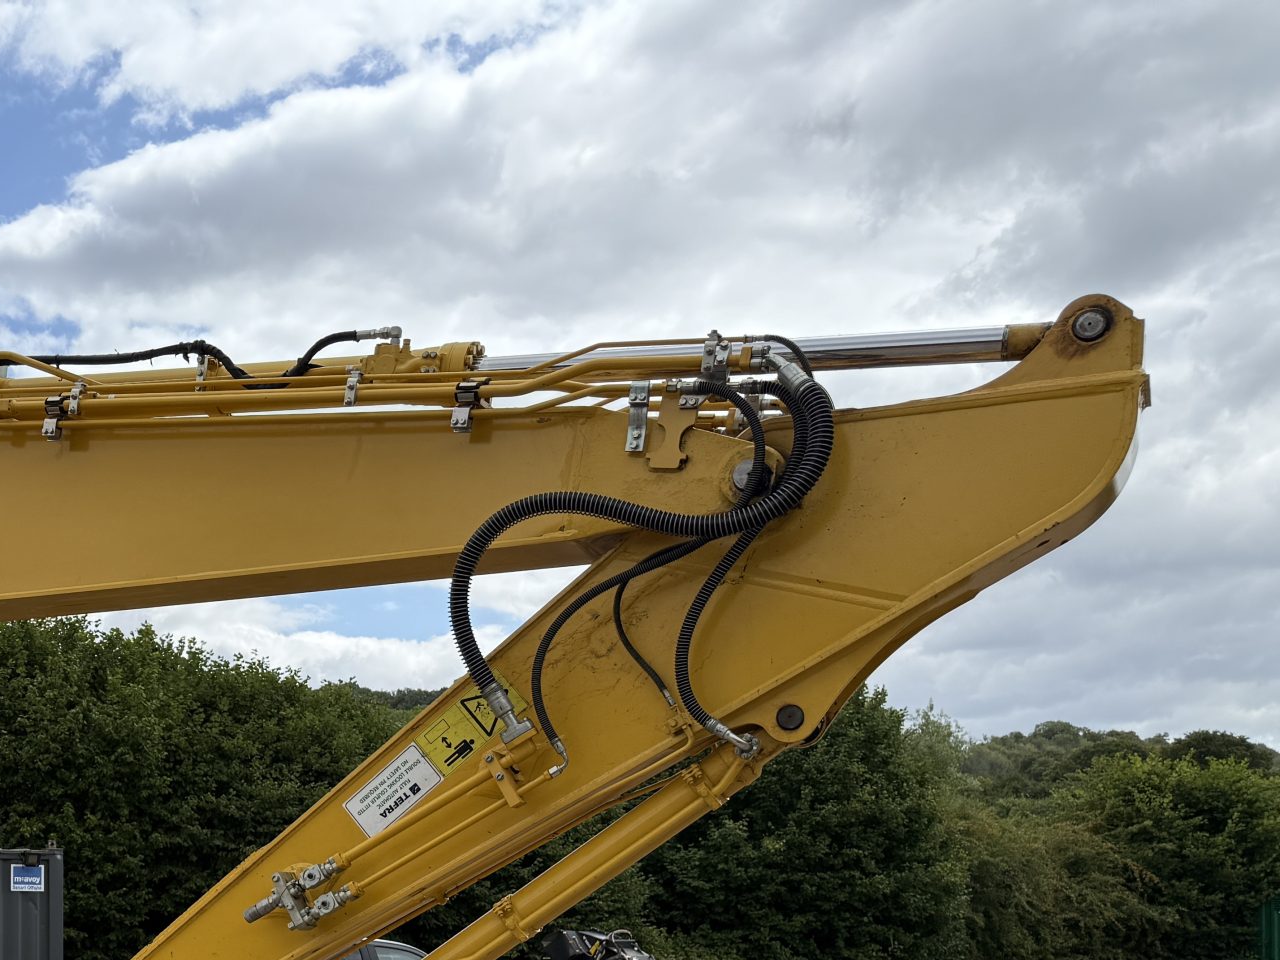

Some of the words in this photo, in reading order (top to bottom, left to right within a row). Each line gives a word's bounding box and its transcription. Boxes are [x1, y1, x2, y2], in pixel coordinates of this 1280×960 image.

[401, 759, 409, 768] NO
[406, 759, 421, 775] DOUBLE
[386, 766, 402, 781] SAFETY
[388, 772, 406, 789] LOCKING
[399, 778, 411, 791] FULLY
[359, 785, 379, 804] REQUIRED
[371, 787, 389, 805] COUPLER
[377, 789, 399, 809] AUTOMATIC
[357, 802, 371, 816] FITTED
[379, 792, 411, 818] TEFRA
